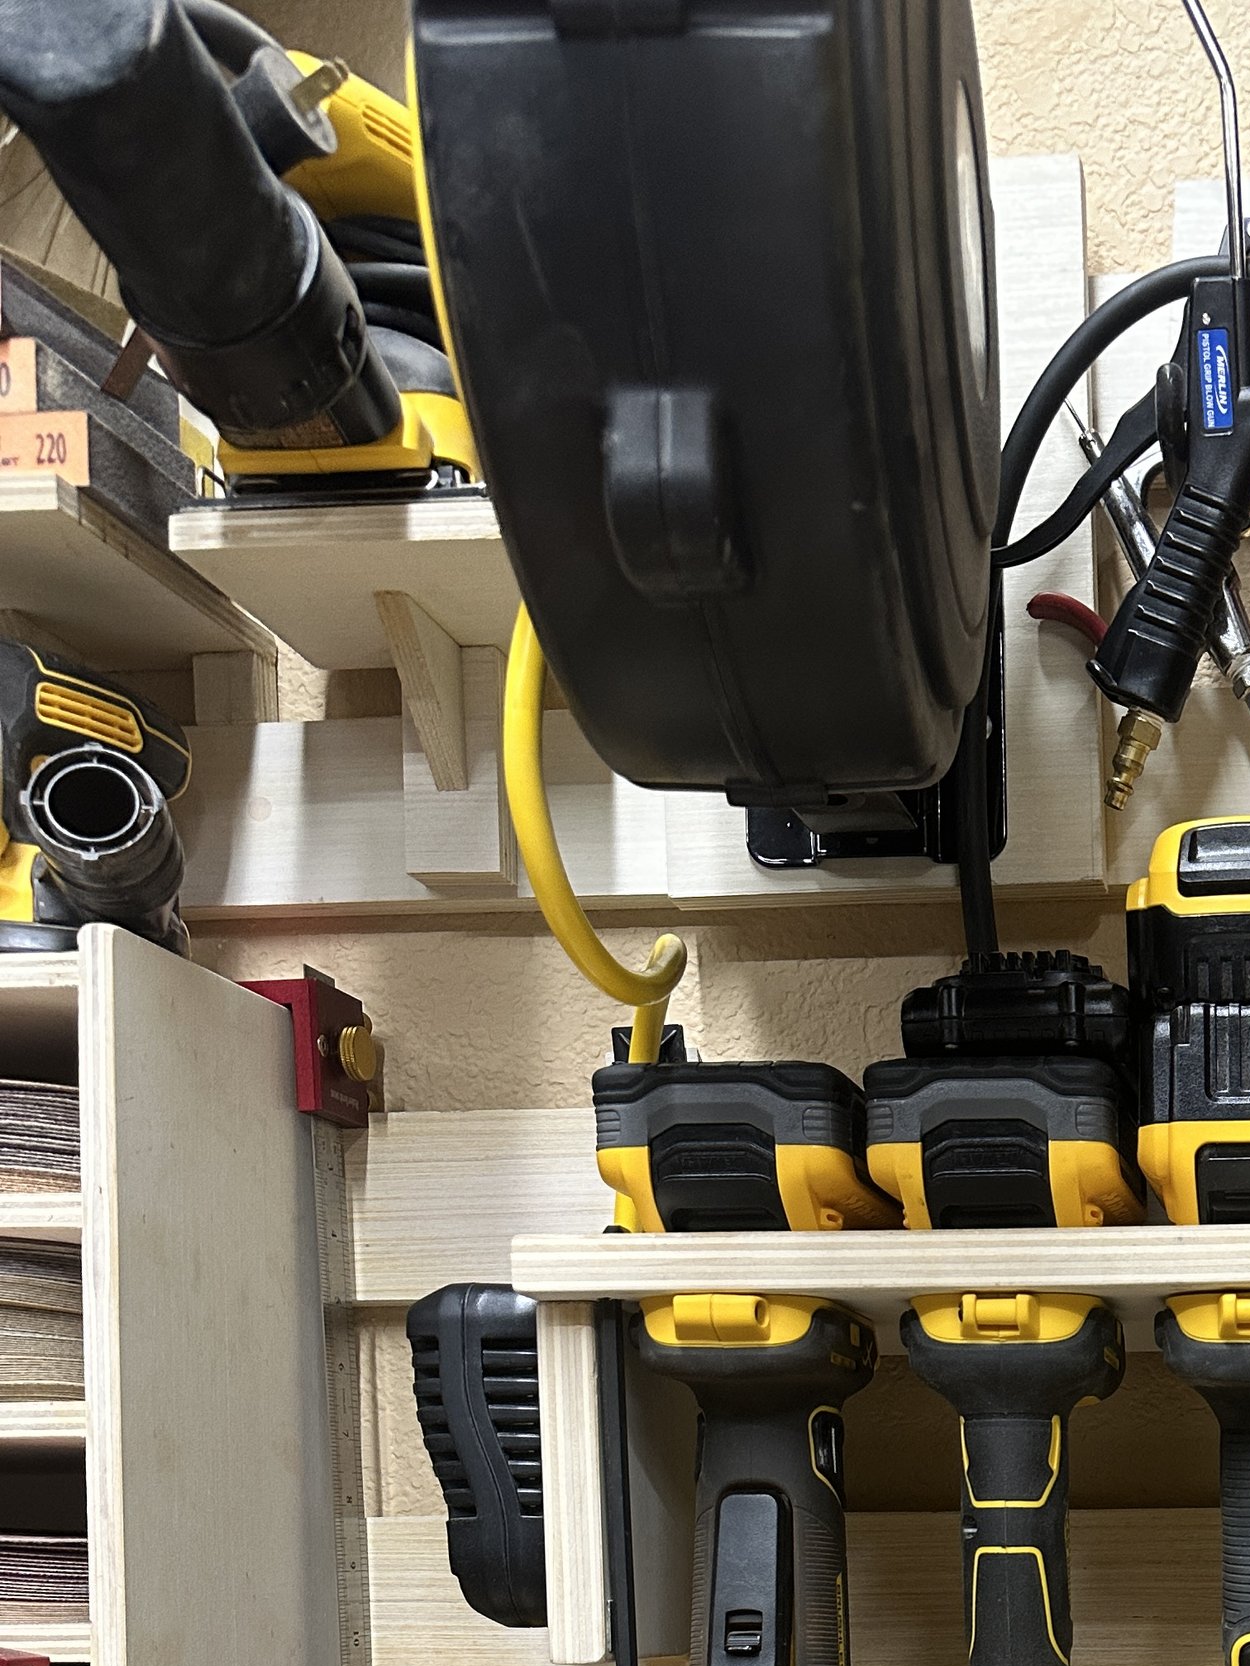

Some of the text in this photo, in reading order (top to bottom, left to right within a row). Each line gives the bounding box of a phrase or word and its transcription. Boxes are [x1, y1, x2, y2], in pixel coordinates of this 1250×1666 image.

[1202, 333, 1216, 428] PISTOL GRIP BLOW GUN
[1216, 355, 1228, 406] MERLIN
[36, 432, 67, 465] 220
